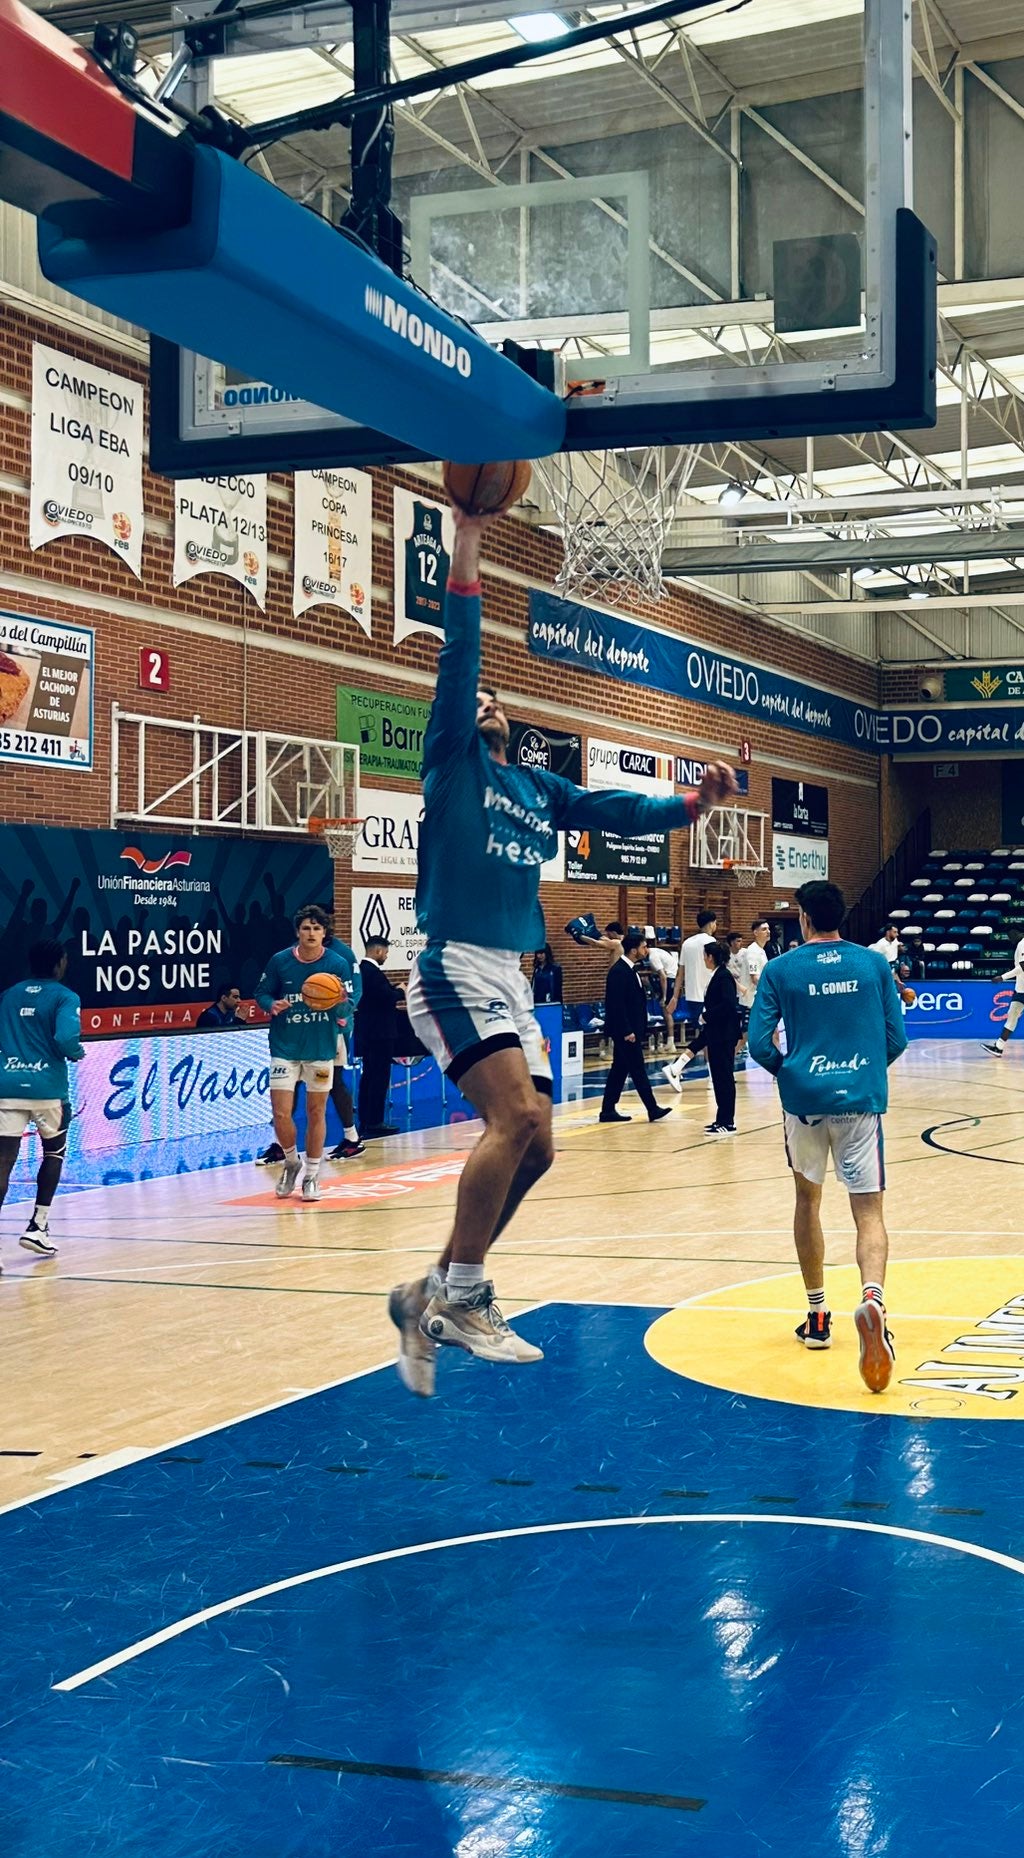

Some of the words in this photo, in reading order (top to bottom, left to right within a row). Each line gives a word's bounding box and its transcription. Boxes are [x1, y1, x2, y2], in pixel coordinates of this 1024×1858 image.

[384, 294, 472, 378] MONDO
[46, 368, 134, 416] CAMPEON
[50, 412, 94, 444] LIGA
[99, 429, 130, 457] EBA
[68, 463, 114, 493] 09/10
[200, 475, 255, 499] DECCO
[311, 469, 357, 494] CAMPEON
[49, 502, 94, 524] OVIEDO
[322, 498, 347, 517] COPA
[180, 498, 228, 528] PLATA
[233, 516, 265, 542] 12/13
[312, 520, 358, 546] PRINCESA
[190, 543, 228, 562] OVIEDO
[324, 551, 347, 568] 16/17
[418, 551, 438, 586] 12
[304, 577, 337, 594] OVIEDO
[9, 625, 28, 644] del
[31, 628, 87, 654] Campillín
[533, 621, 580, 654] capital
[584, 630, 603, 661] del
[607, 638, 649, 673] deporte
[42, 667, 51, 678] EL
[52, 669, 78, 683] MEJOR
[149, 652, 162, 685] 2
[39, 680, 76, 696] CACHOPO
[687, 652, 759, 705] OVIEDO
[762, 693, 790, 717] capital
[791, 698, 804, 720] del
[805, 702, 831, 728] deporte
[1008, 686, 1021, 695] DE
[50, 696, 61, 707] DE
[351, 695, 416, 716] RECUPERACION
[33, 708, 70, 723] ASTURIAS
[854, 709, 943, 744] OVIEDO
[948, 723, 1010, 746] capital
[15, 734, 37, 754] 212
[41, 738, 62, 756] 411
[744, 742, 750, 761] 3
[589, 746, 619, 769] grupo
[788, 847, 826, 876] Enerthy
[134, 894, 157, 905] Desde
[159, 895, 177, 907] 1984
[81, 929, 117, 956] LA
[128, 923, 222, 956] PASIÓN
[95, 965, 150, 992] NOS
[161, 964, 210, 989] UNE
[809, 983, 820, 996] D.
[822, 980, 858, 995] GOMEZ
[809, 1052, 870, 1074] Pomada
[104, 1054, 158, 1120] El
[169, 1054, 270, 1110] Vasco
[831, 1116, 857, 1124] center
